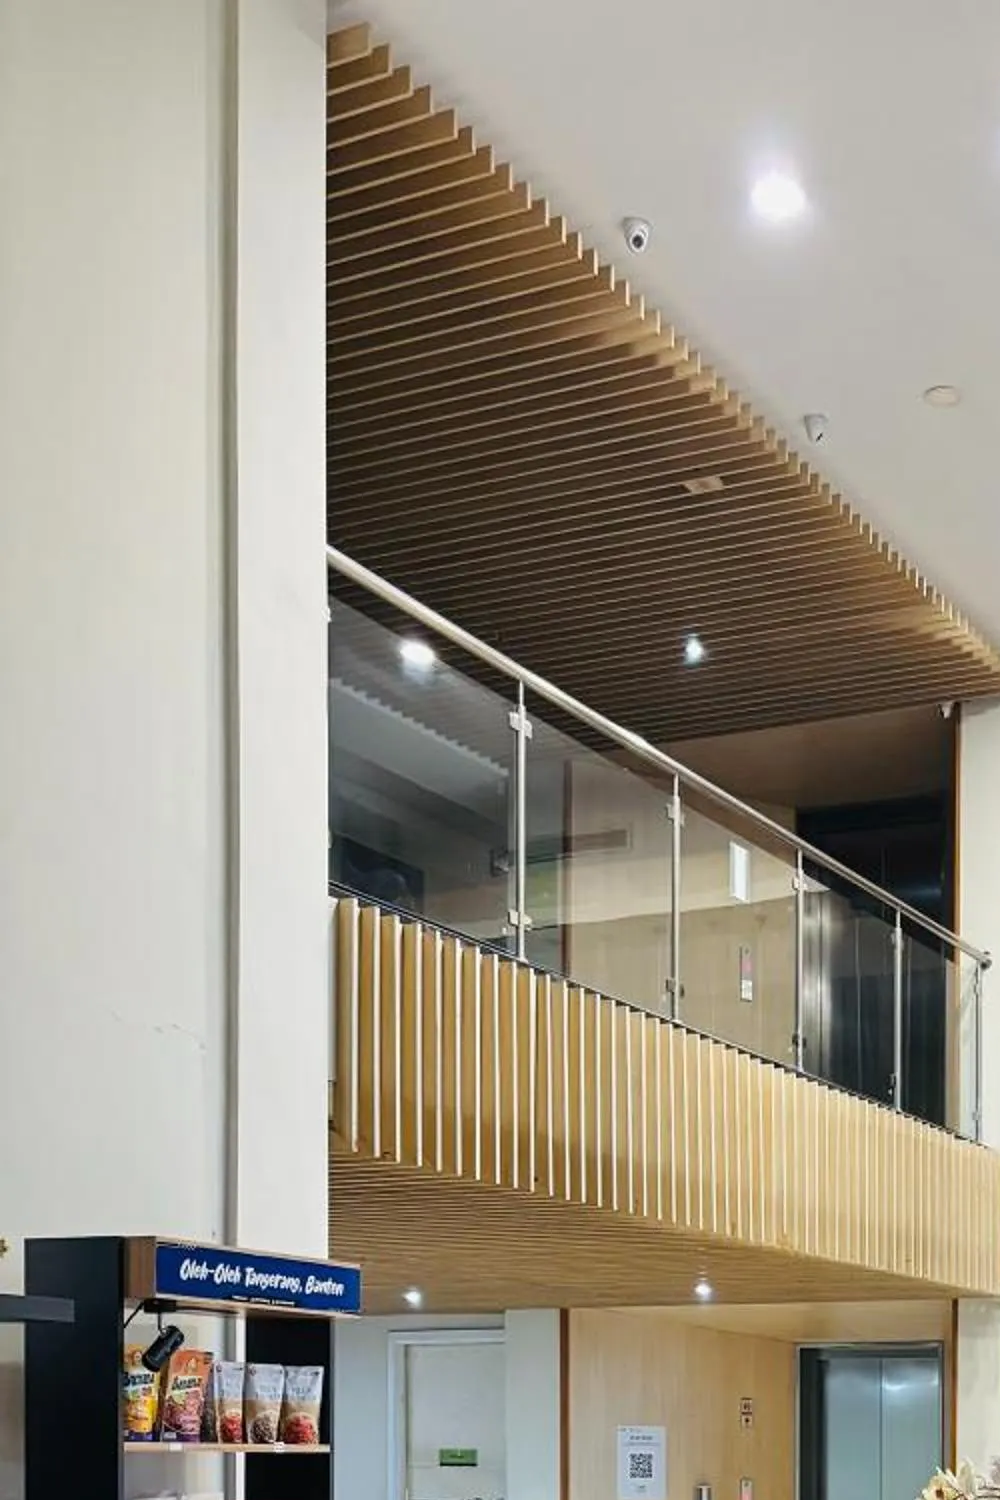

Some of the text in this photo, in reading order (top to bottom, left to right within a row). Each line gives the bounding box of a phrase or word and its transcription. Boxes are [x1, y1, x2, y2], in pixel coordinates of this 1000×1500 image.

[179, 1258, 345, 1297] Oleh-Oleh Tangerang, Banten
